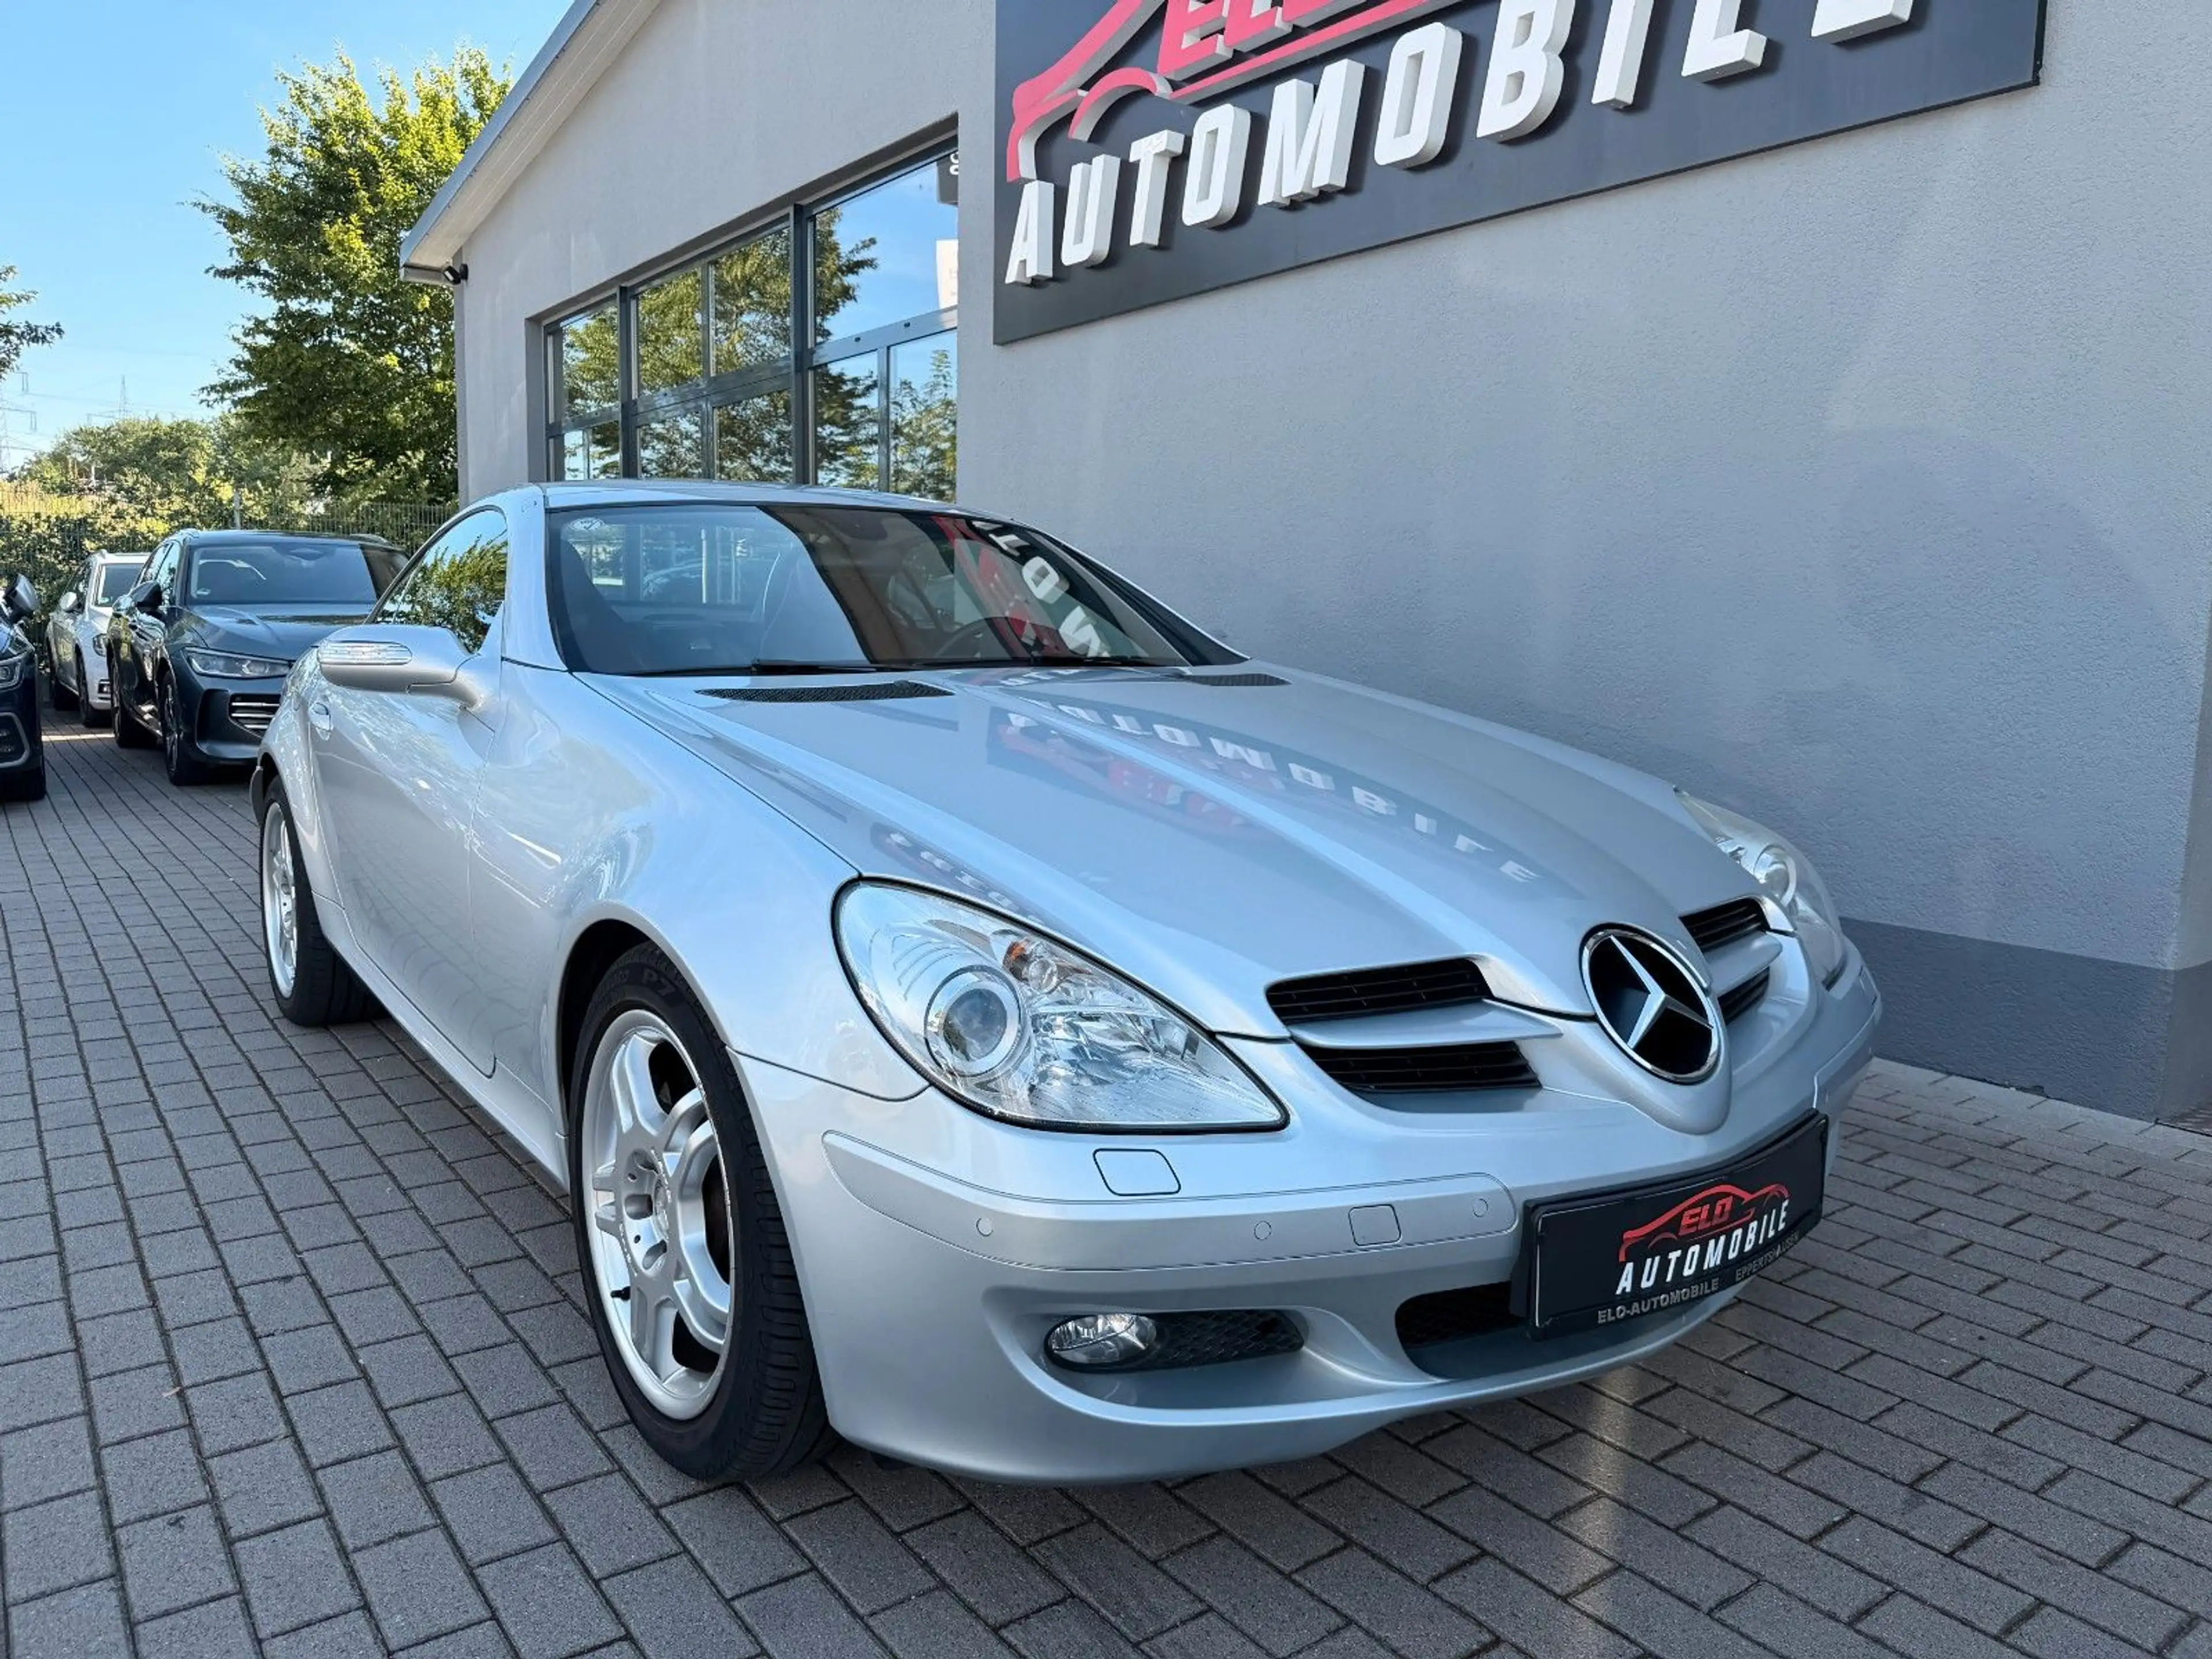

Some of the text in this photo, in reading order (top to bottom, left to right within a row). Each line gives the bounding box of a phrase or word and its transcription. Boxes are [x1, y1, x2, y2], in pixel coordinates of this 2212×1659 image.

[1678, 1196, 1733, 1236] ELO
[1615, 1199, 1789, 1295] AUTOMOBILE
[1597, 1278, 1719, 1324] ELO-AUTOMOBILE
